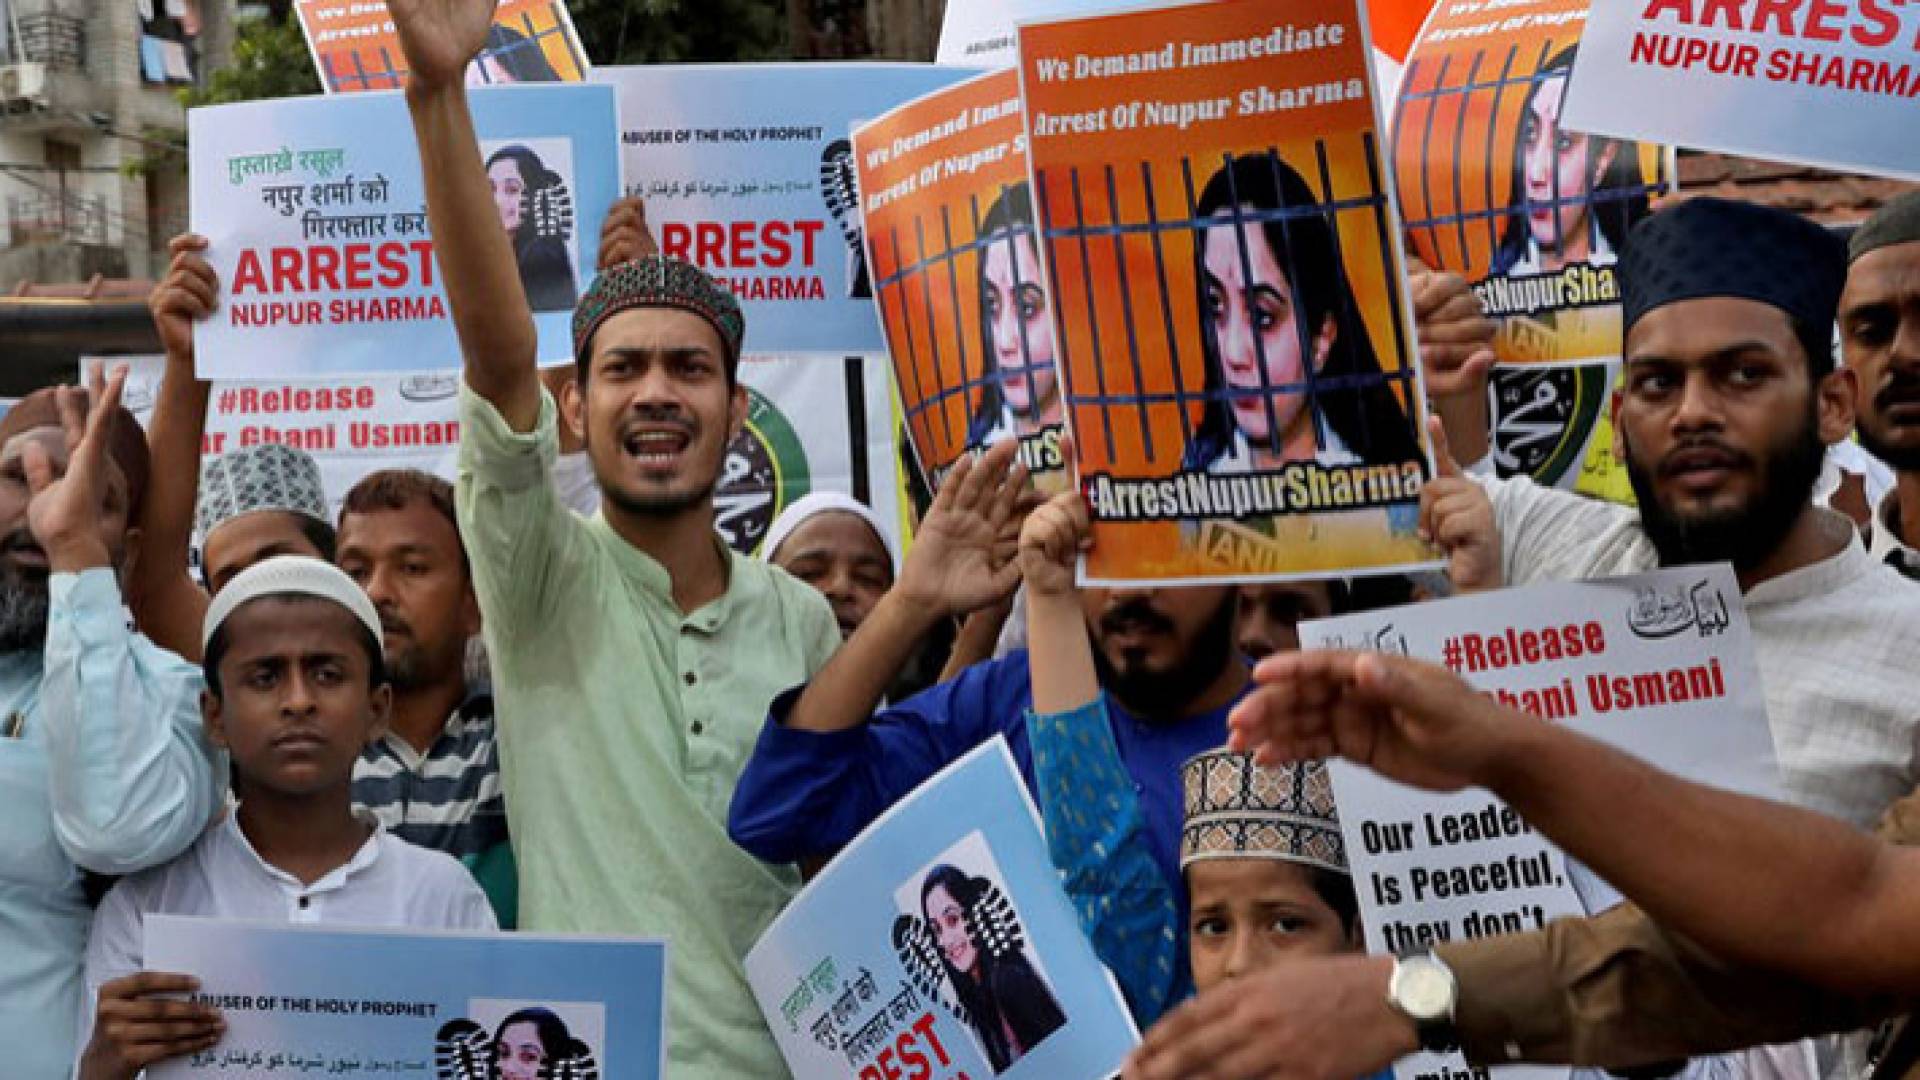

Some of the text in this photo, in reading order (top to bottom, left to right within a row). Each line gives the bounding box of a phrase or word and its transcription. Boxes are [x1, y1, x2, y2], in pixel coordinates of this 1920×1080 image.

[1036, 23, 1345, 82] We Demand Immediate
[1630, 31, 1759, 76] NUPUR
[1034, 78, 1364, 137] Arrest Of Nupur Sharma
[695, 127, 719, 143] THE
[722, 126, 757, 144] HOLY
[760, 126, 823, 142] PROPHET
[310, 174, 354, 206] शर्मा
[359, 172, 390, 204] को
[661, 220, 825, 268] RREST
[231, 239, 434, 295] ARREST
[712, 274, 825, 301] HARMA
[231, 294, 446, 327] NUPUR SHARMA
[217, 385, 375, 415] #Release
[350, 421, 460, 449] Usman
[1441, 619, 1607, 675] #Release
[1585, 656, 1725, 714] Usmani
[1361, 820, 1414, 855] Our
[1371, 871, 1401, 907] Is
[256, 995, 279, 1012] OF
[281, 996, 312, 1013] THE
[314, 998, 358, 1015] HOLY
[361, 1000, 438, 1019] PROPHET
